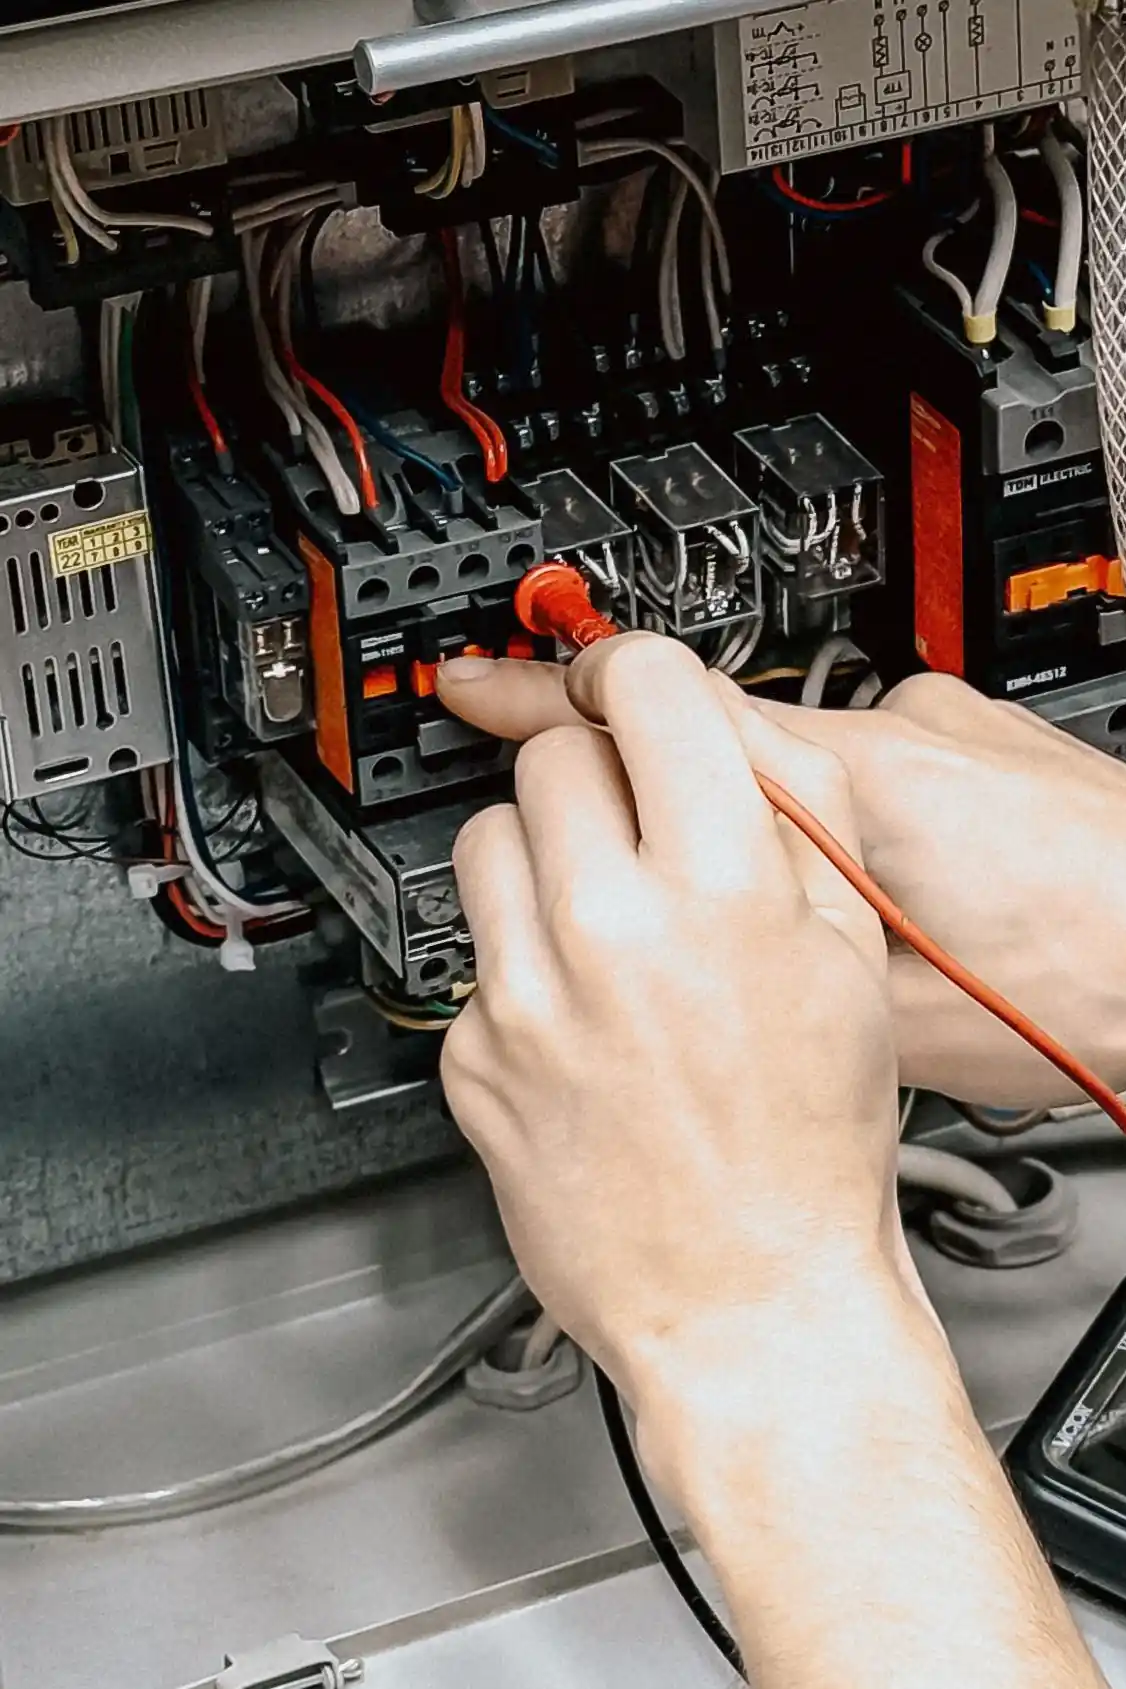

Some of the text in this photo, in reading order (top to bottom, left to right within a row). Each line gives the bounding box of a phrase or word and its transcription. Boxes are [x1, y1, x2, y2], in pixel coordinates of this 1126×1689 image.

[1048, 83, 1056, 94] 2
[1017, 89, 1025, 102] 3
[943, 106, 951, 118] 5
[901, 116, 908, 127] 7
[814, 135, 825, 147] 11
[836, 130, 848, 142] 10
[771, 145, 783, 157] 13
[792, 139, 805, 152] 12
[751, 150, 763, 161] 14
[1005, 462, 1093, 495] TDM ELECTRIC
[57, 535, 80, 550] YEAR
[133, 526, 141, 537] 3
[61, 552, 81, 570] 22
[91, 551, 99, 562] 7
